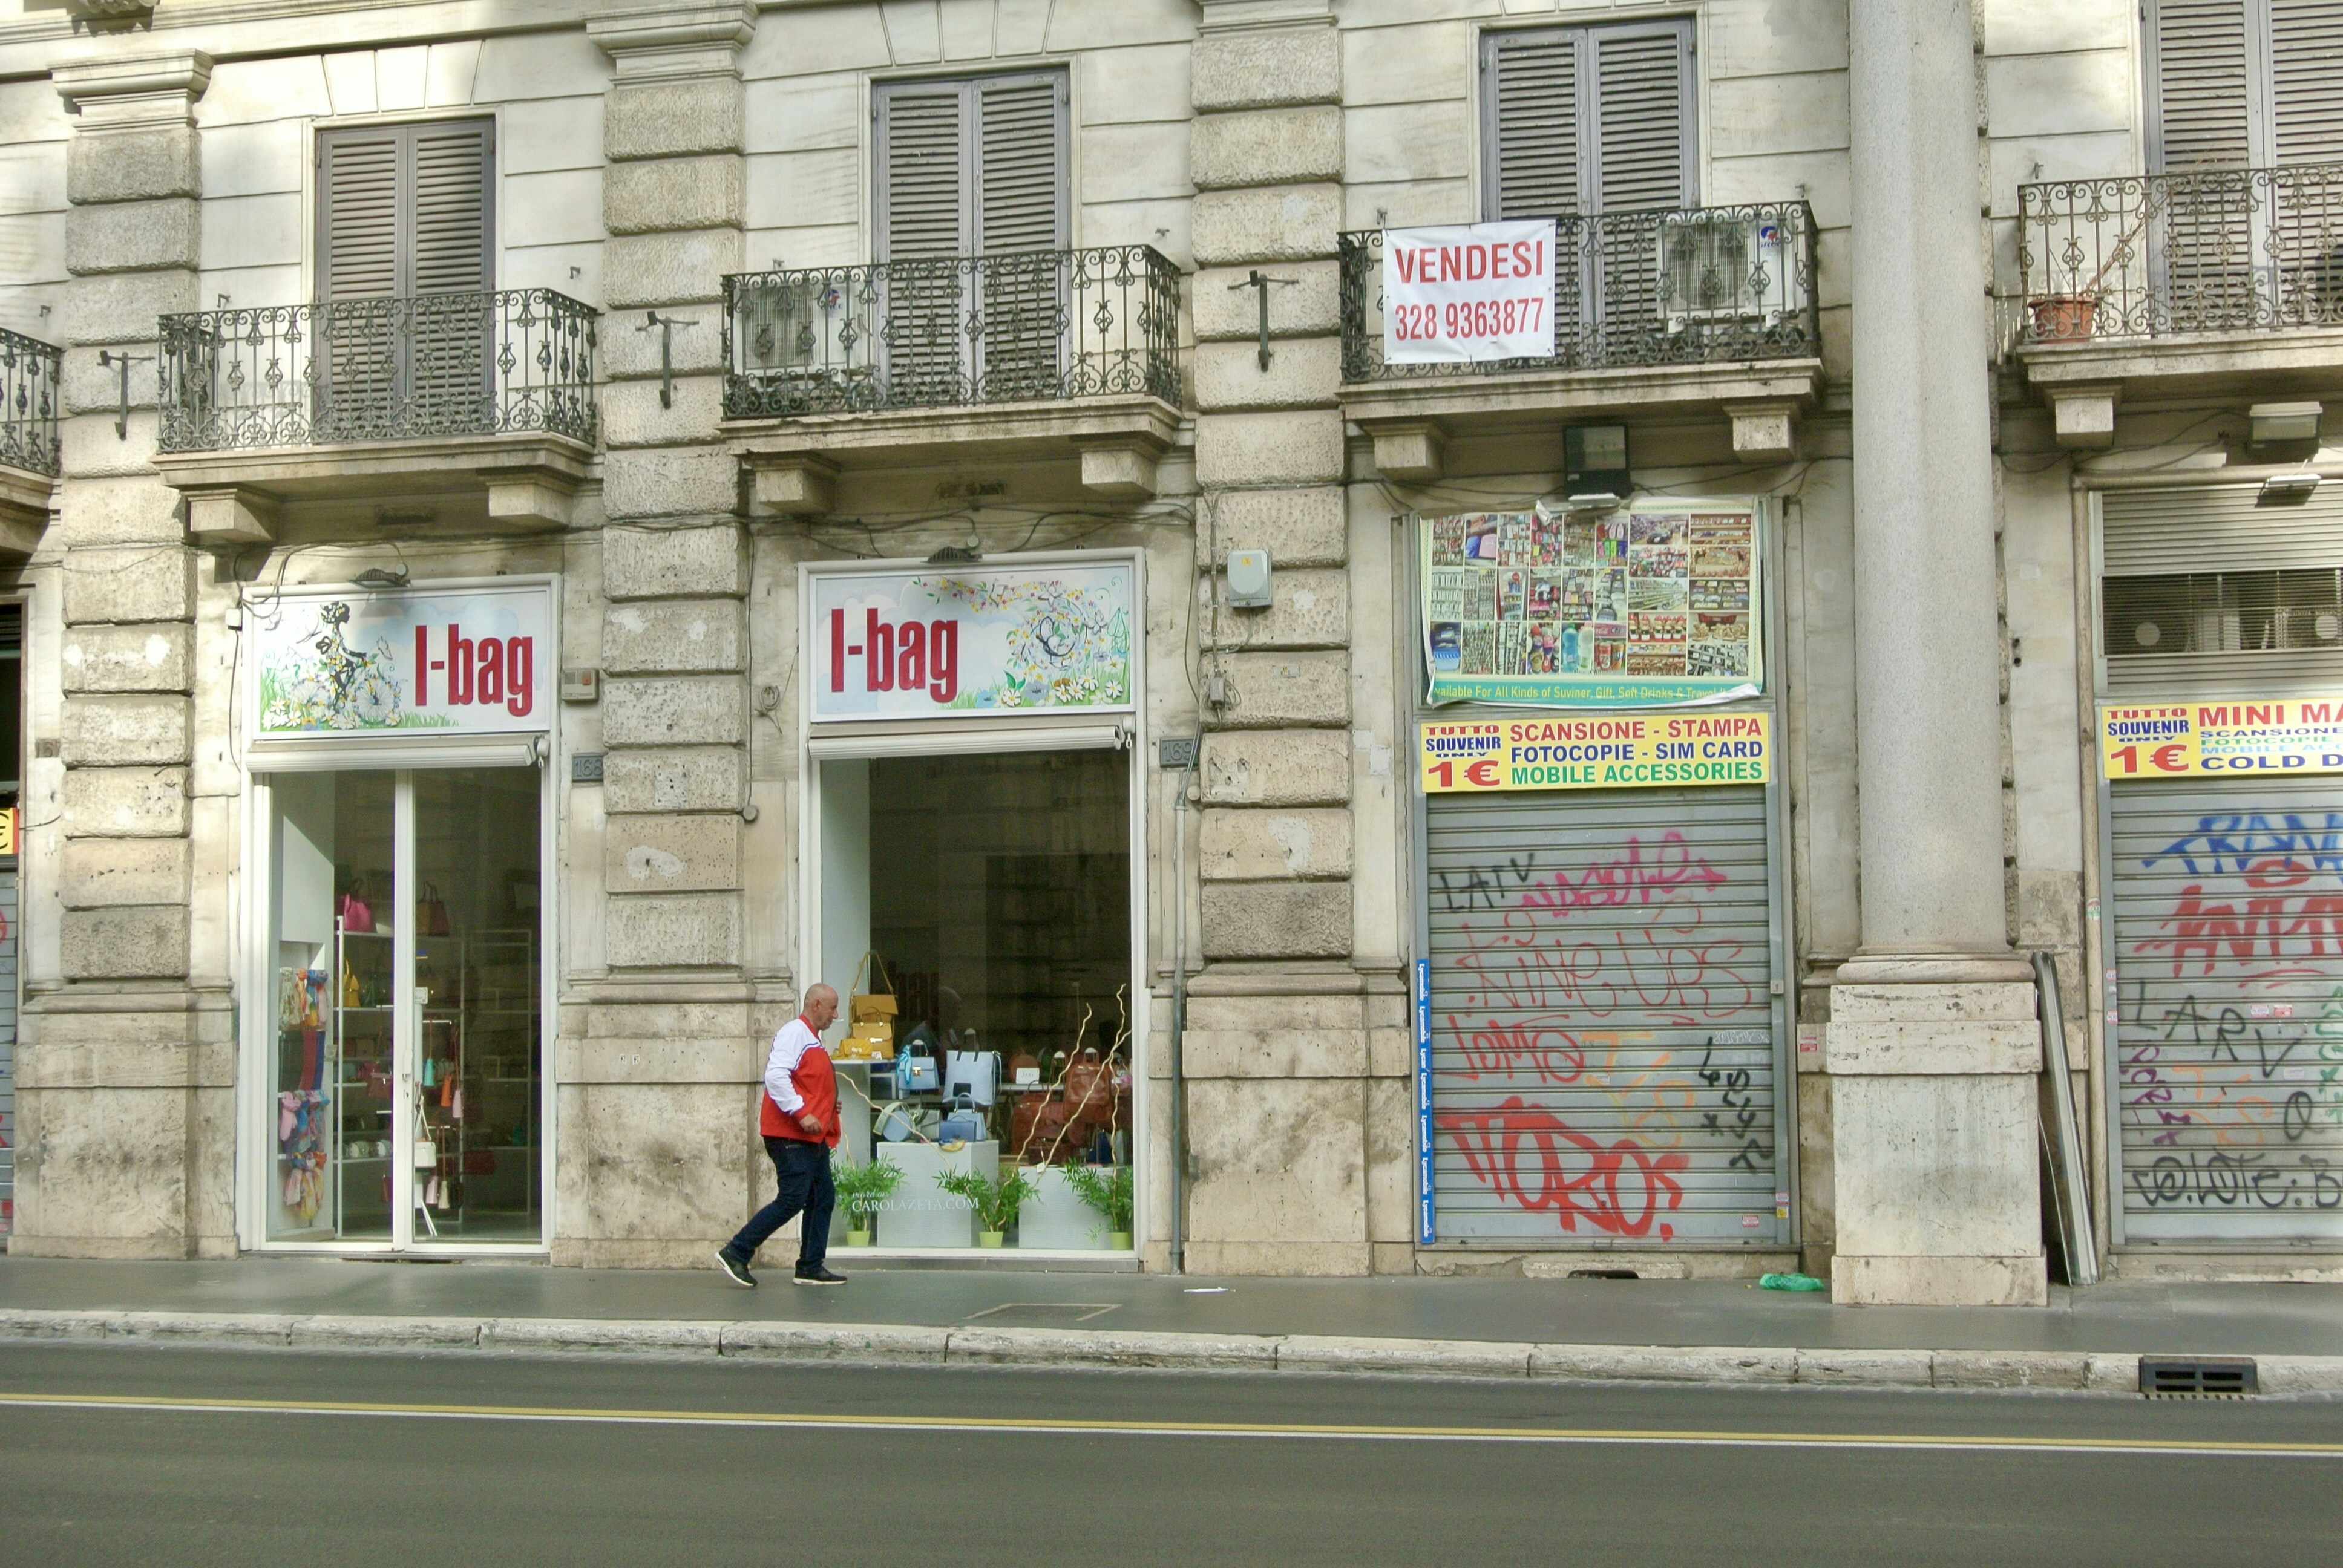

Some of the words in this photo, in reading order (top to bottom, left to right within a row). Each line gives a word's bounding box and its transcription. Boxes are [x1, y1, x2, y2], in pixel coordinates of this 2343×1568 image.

[1395, 240, 1543, 284] VENDESI
[1395, 304, 1437, 340] 328
[1446, 297, 1544, 338] 9363877
[1434, 685, 1472, 697] vailable
[1476, 686, 1492, 697] For
[1495, 686, 1508, 697] All
[1512, 686, 1538, 697] Kinds
[1541, 686, 1551, 697] of
[1619, 687, 1637, 698] Soft
[1640, 687, 1674, 698] Drinks
[2107, 708, 2187, 719] TUTTO
[2198, 705, 2284, 727] MINI
[1426, 725, 1499, 736] TUTTO
[1510, 722, 1645, 742] SCANSIONE
[1668, 718, 1762, 738] STAMPA
[2108, 720, 2189, 736] SOUVENIR
[2200, 727, 2343, 738] SCANSIONE
[1426, 737, 1501, 751] SOUVENIR
[2201, 736, 2333, 746] FOTOCOPIE
[2201, 744, 2292, 754] MOBILE
[1163, 742, 1194, 762] 169
[1512, 744, 1634, 763] FOTOCOPIE
[1656, 742, 1694, 759] SIM
[1703, 741, 1763, 758] CARD
[575, 759, 603, 777] 168
[2201, 755, 2305, 770] COLD
[1512, 765, 1596, 785] MOBILE
[1604, 762, 1763, 783] ACCESSORIES
